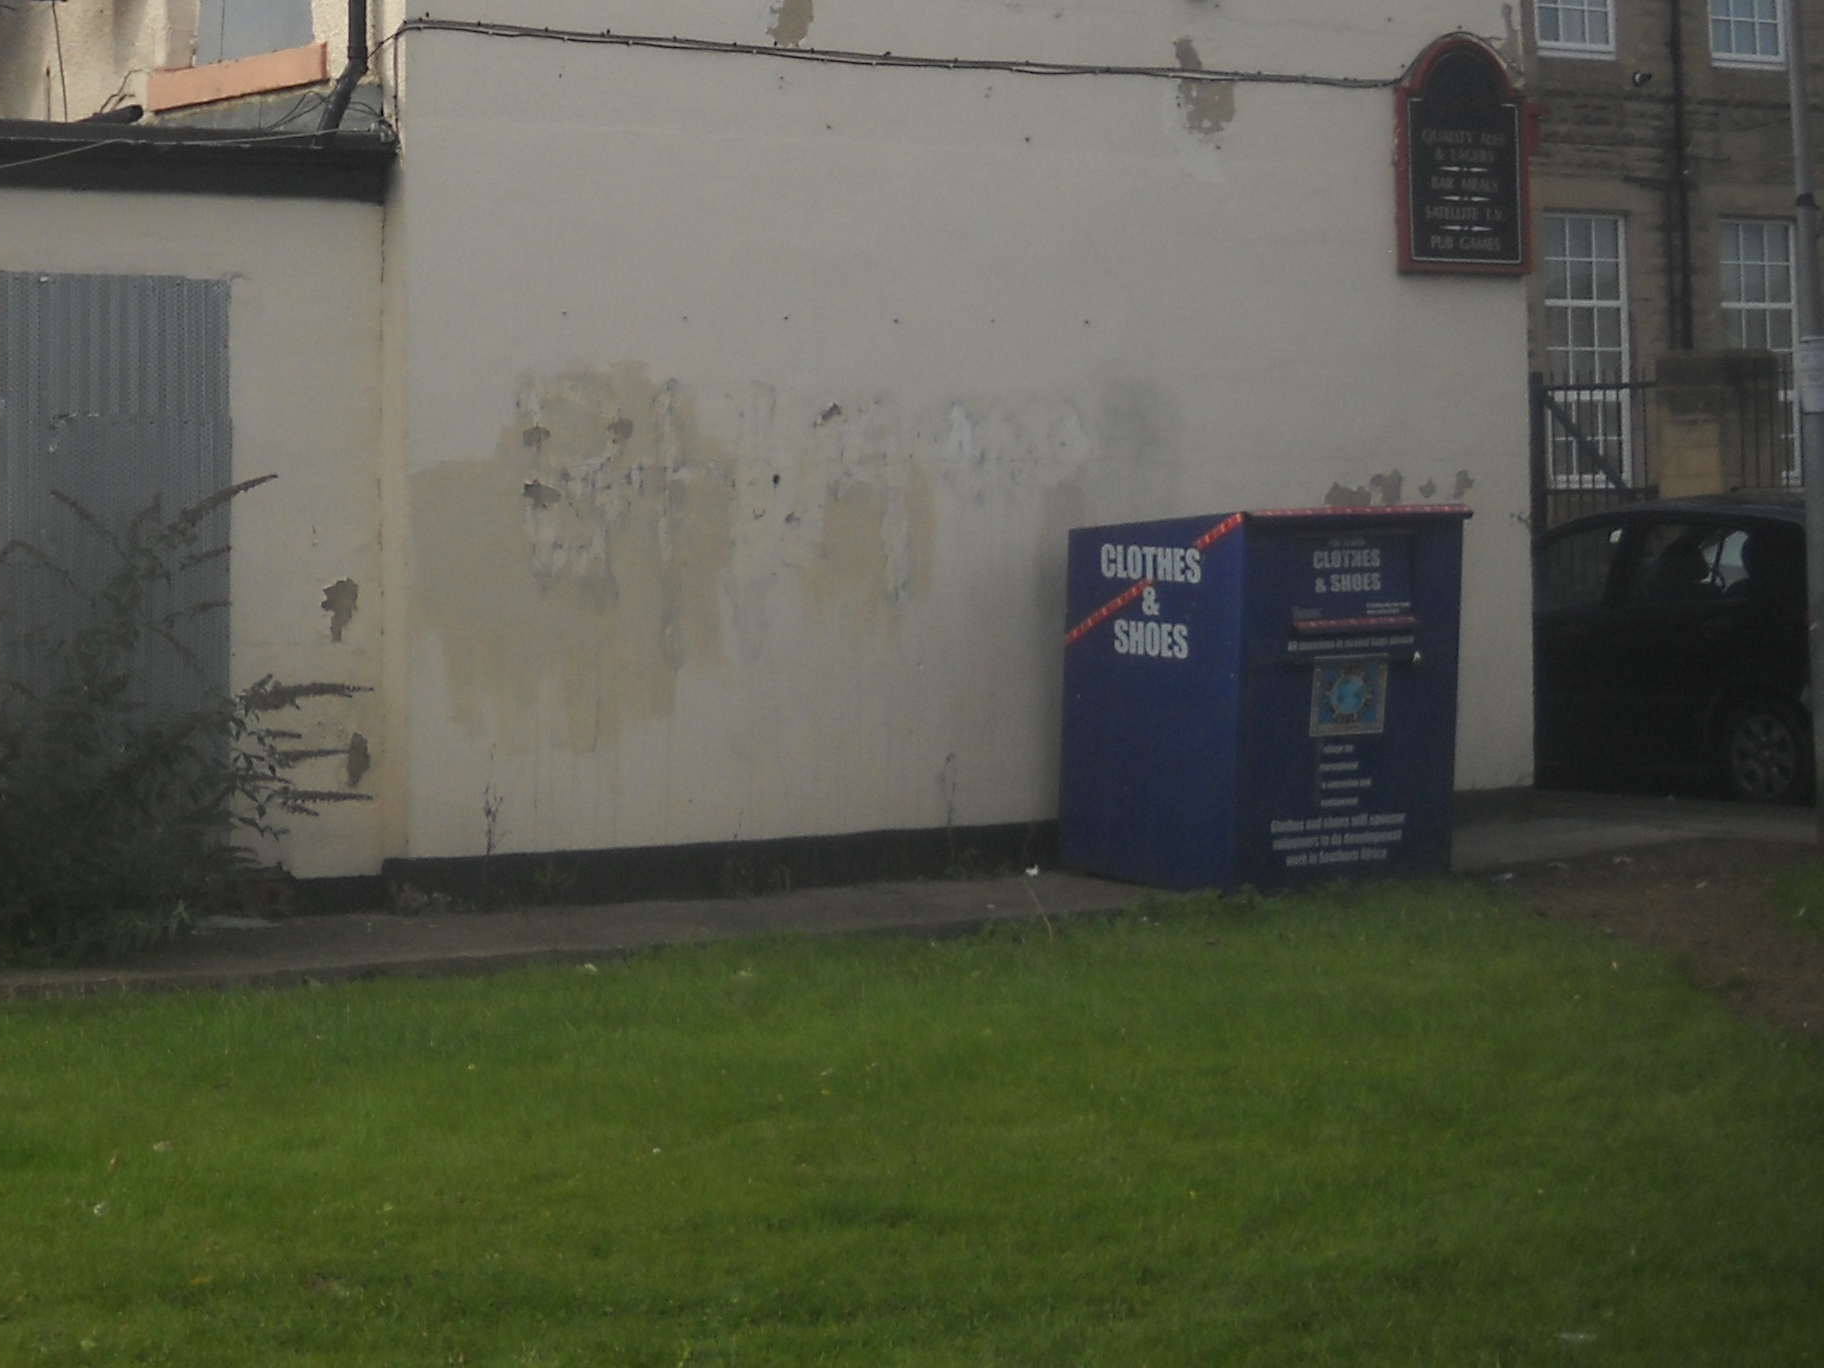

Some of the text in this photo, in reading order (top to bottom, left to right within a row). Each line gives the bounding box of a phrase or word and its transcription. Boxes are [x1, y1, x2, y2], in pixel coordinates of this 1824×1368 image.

[1459, 236, 1501, 252] GAMES
[1100, 543, 1201, 583] CLOTHES
[1313, 548, 1381, 569] CLOTHES
[1315, 572, 1381, 593] & SHOES
[1142, 586, 1160, 616] &
[1114, 619, 1188, 659] SHOES
